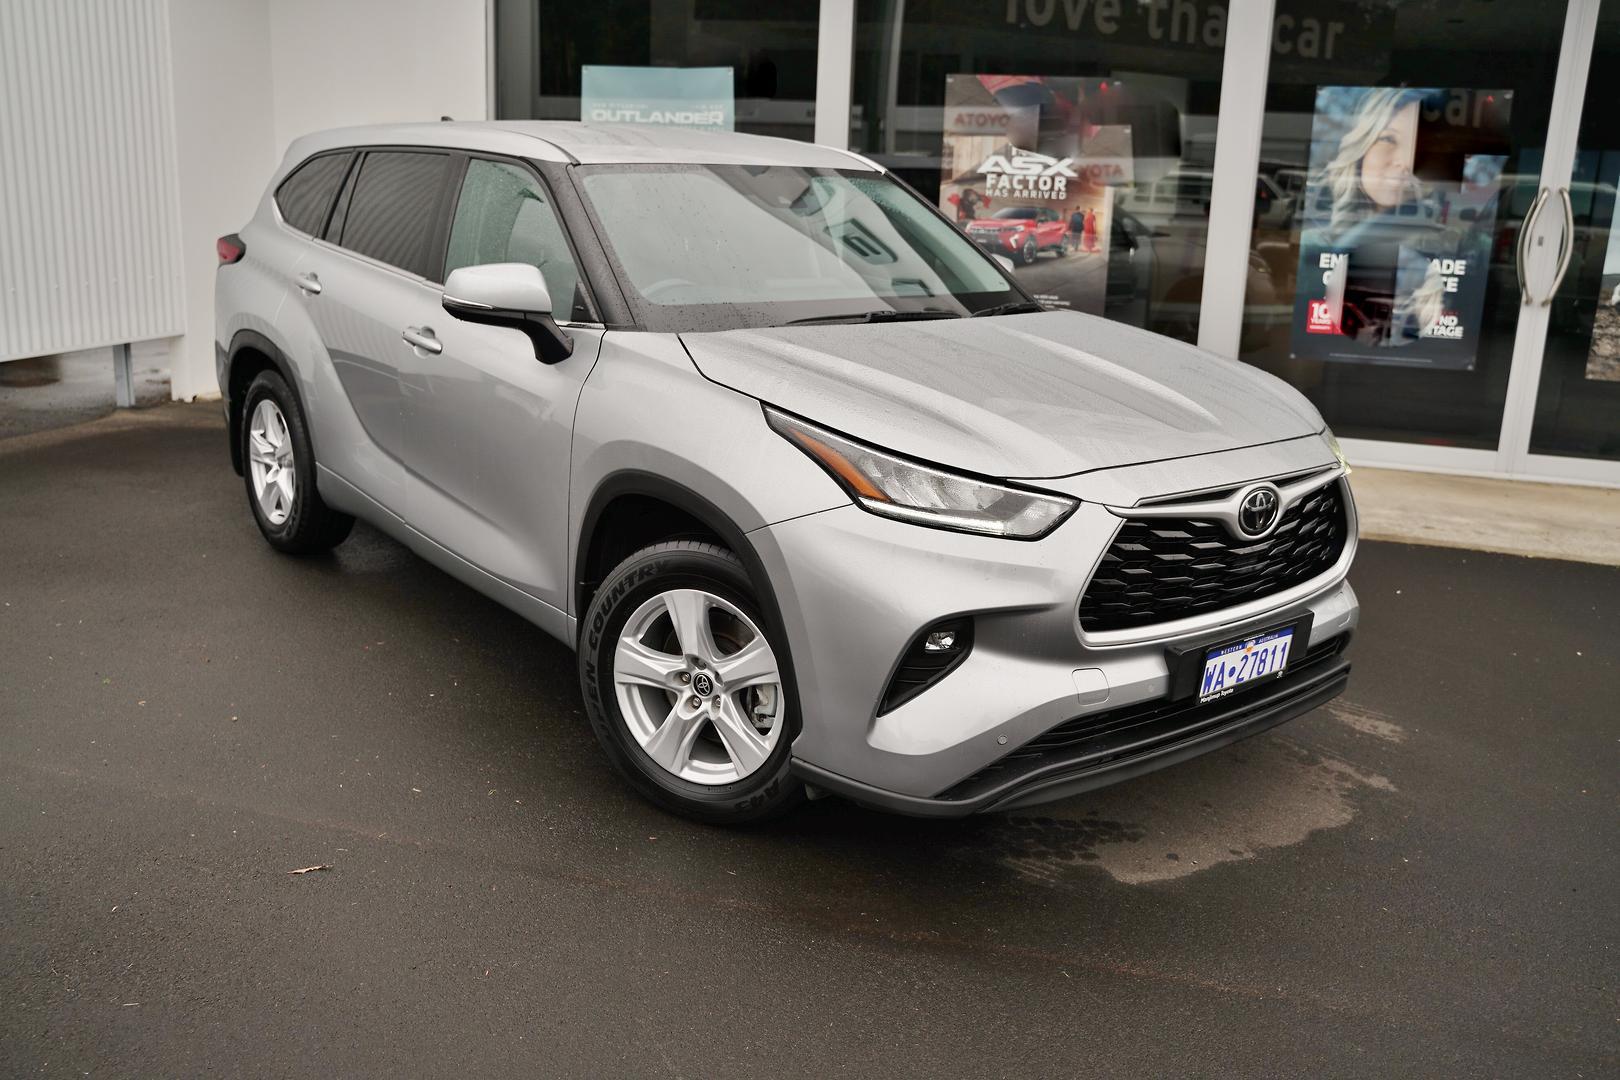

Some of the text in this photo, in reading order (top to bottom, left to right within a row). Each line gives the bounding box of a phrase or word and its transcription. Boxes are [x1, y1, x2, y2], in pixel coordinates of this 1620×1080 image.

[1140, 0, 1226, 47] tha
[1273, 14, 1344, 59] car
[592, 109, 724, 126] OUTLANDER
[976, 152, 1078, 178] ASX
[985, 175, 1067, 192] FACTOR
[985, 189, 1066, 200] HAS ARRIVED
[1431, 258, 1467, 276] ADE
